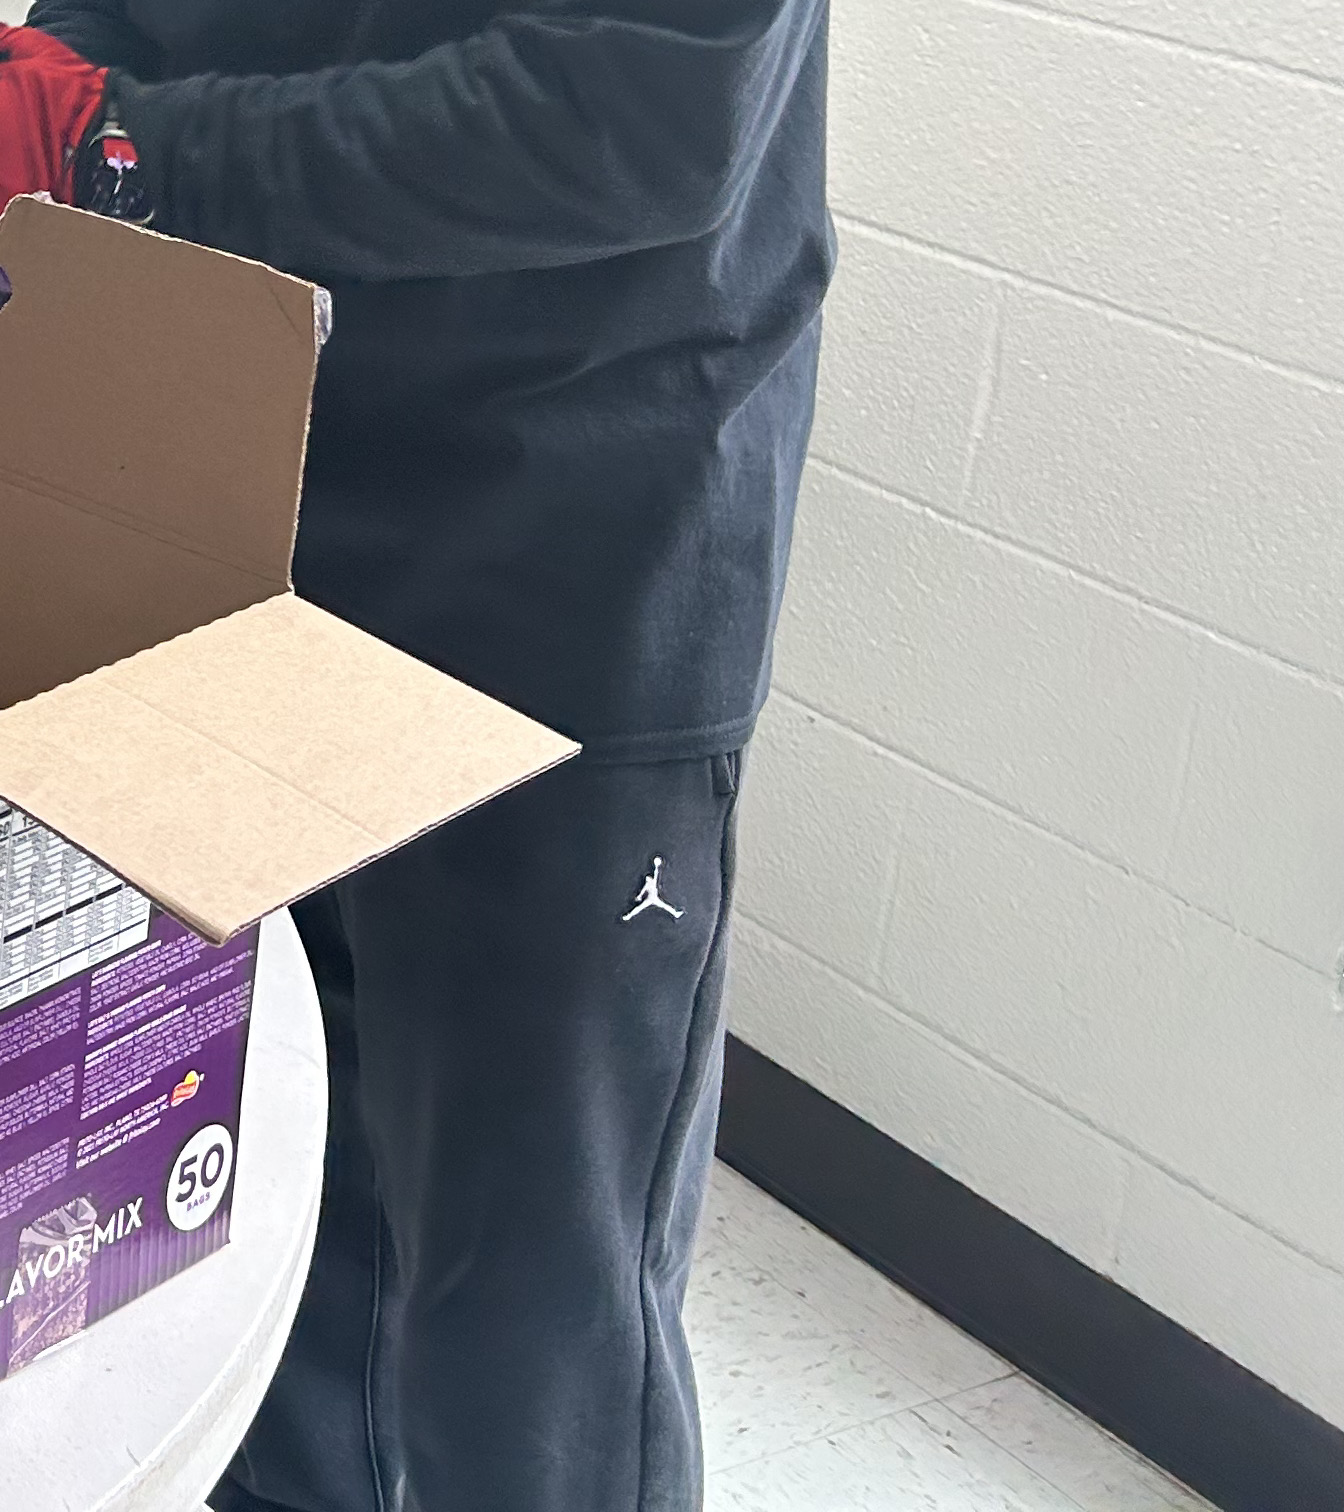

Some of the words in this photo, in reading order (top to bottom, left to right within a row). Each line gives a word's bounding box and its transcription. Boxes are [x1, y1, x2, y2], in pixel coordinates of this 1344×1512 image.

[175, 1143, 224, 1203] 50
[92, 1197, 145, 1253] MIX
[186, 1192, 211, 1212] BAGS
